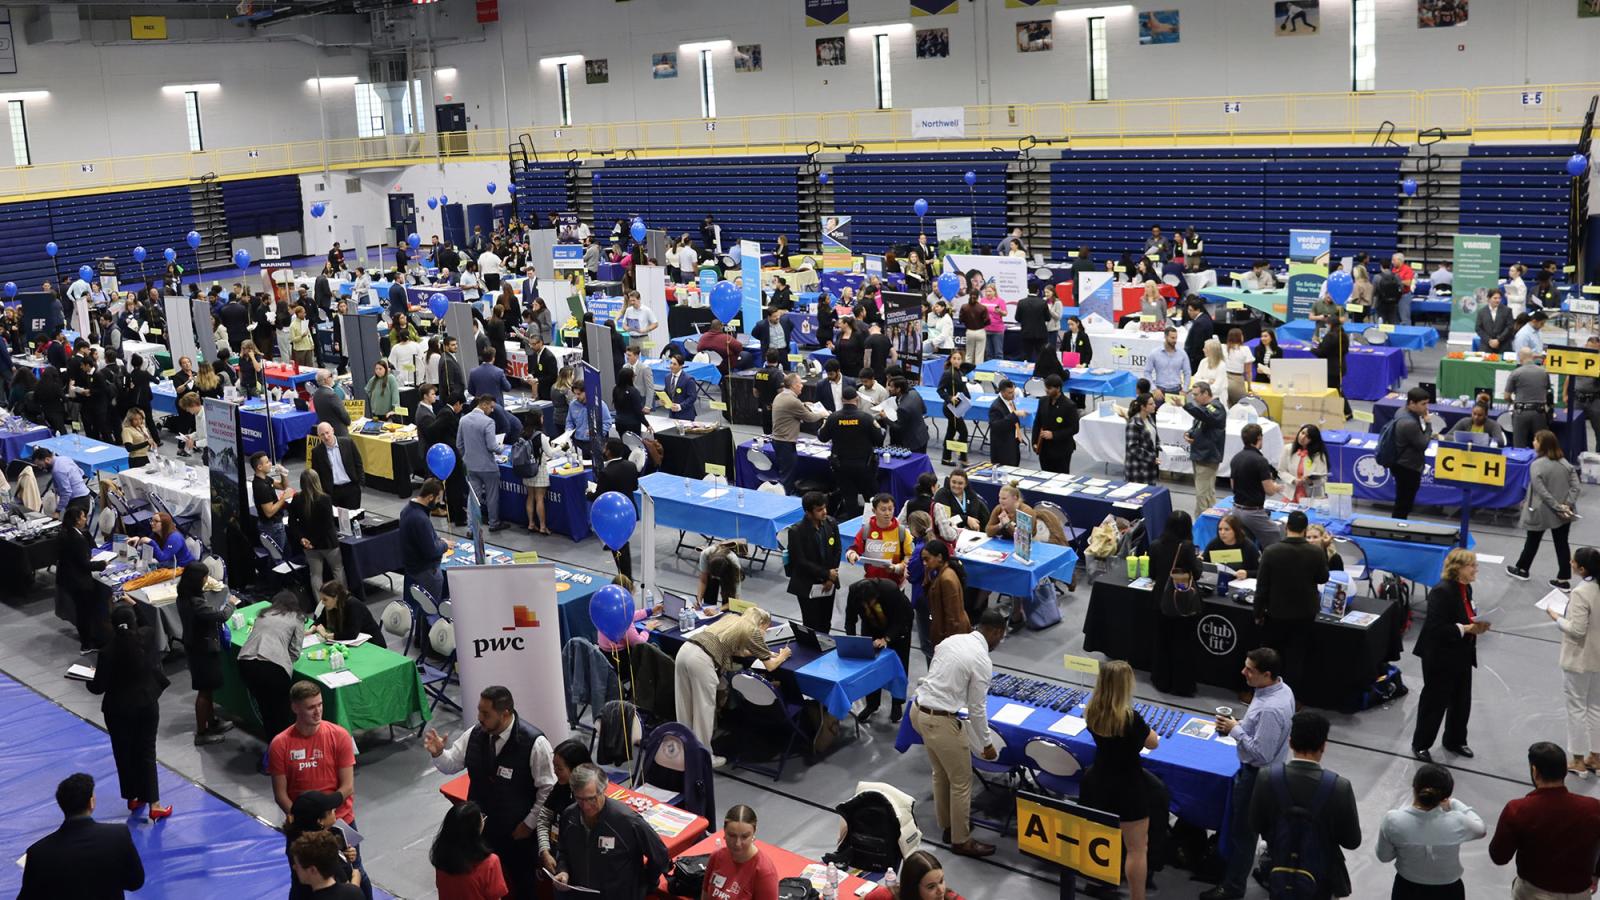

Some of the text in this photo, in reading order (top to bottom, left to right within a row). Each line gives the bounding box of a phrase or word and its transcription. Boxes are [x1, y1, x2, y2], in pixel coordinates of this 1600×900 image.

[922, 119, 959, 129] Northwell
[32, 319, 46, 330] EF
[1202, 622, 1232, 639] club
[473, 636, 525, 658] pwc
[1209, 636, 1225, 650] fit
[299, 761, 318, 771] pwc
[712, 888, 731, 900] pwc
